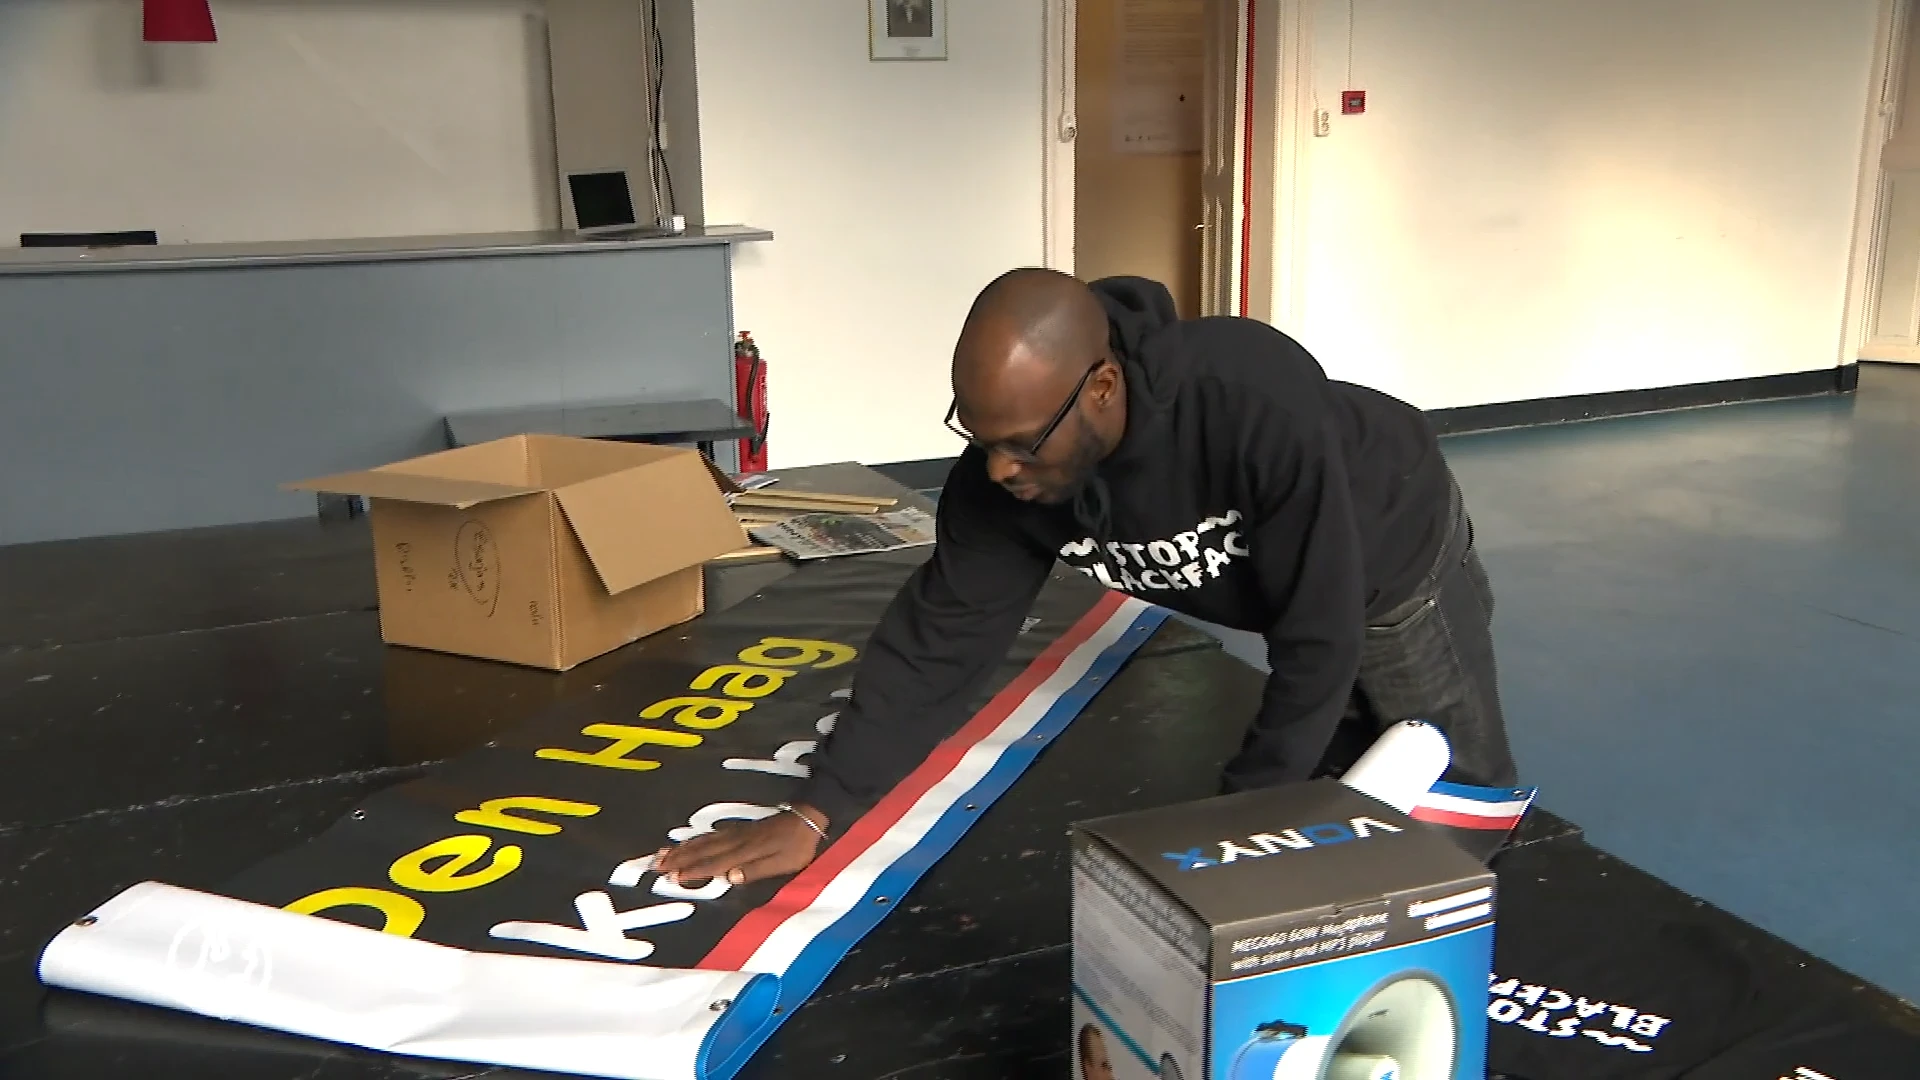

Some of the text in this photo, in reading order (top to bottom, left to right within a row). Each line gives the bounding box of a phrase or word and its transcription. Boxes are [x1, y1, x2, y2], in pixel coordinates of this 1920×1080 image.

[1077, 530, 1250, 592] LACKFAC
[1106, 531, 1201, 568] STOP
[535, 636, 858, 771] Haag
[1160, 816, 1404, 870] VONYX
[1230, 929, 1387, 972] with siren and MP3 player
[1287, 925, 1321, 941] 60W
[1320, 911, 1389, 936] Megaphone
[1488, 972, 1673, 1038] BLACKF
